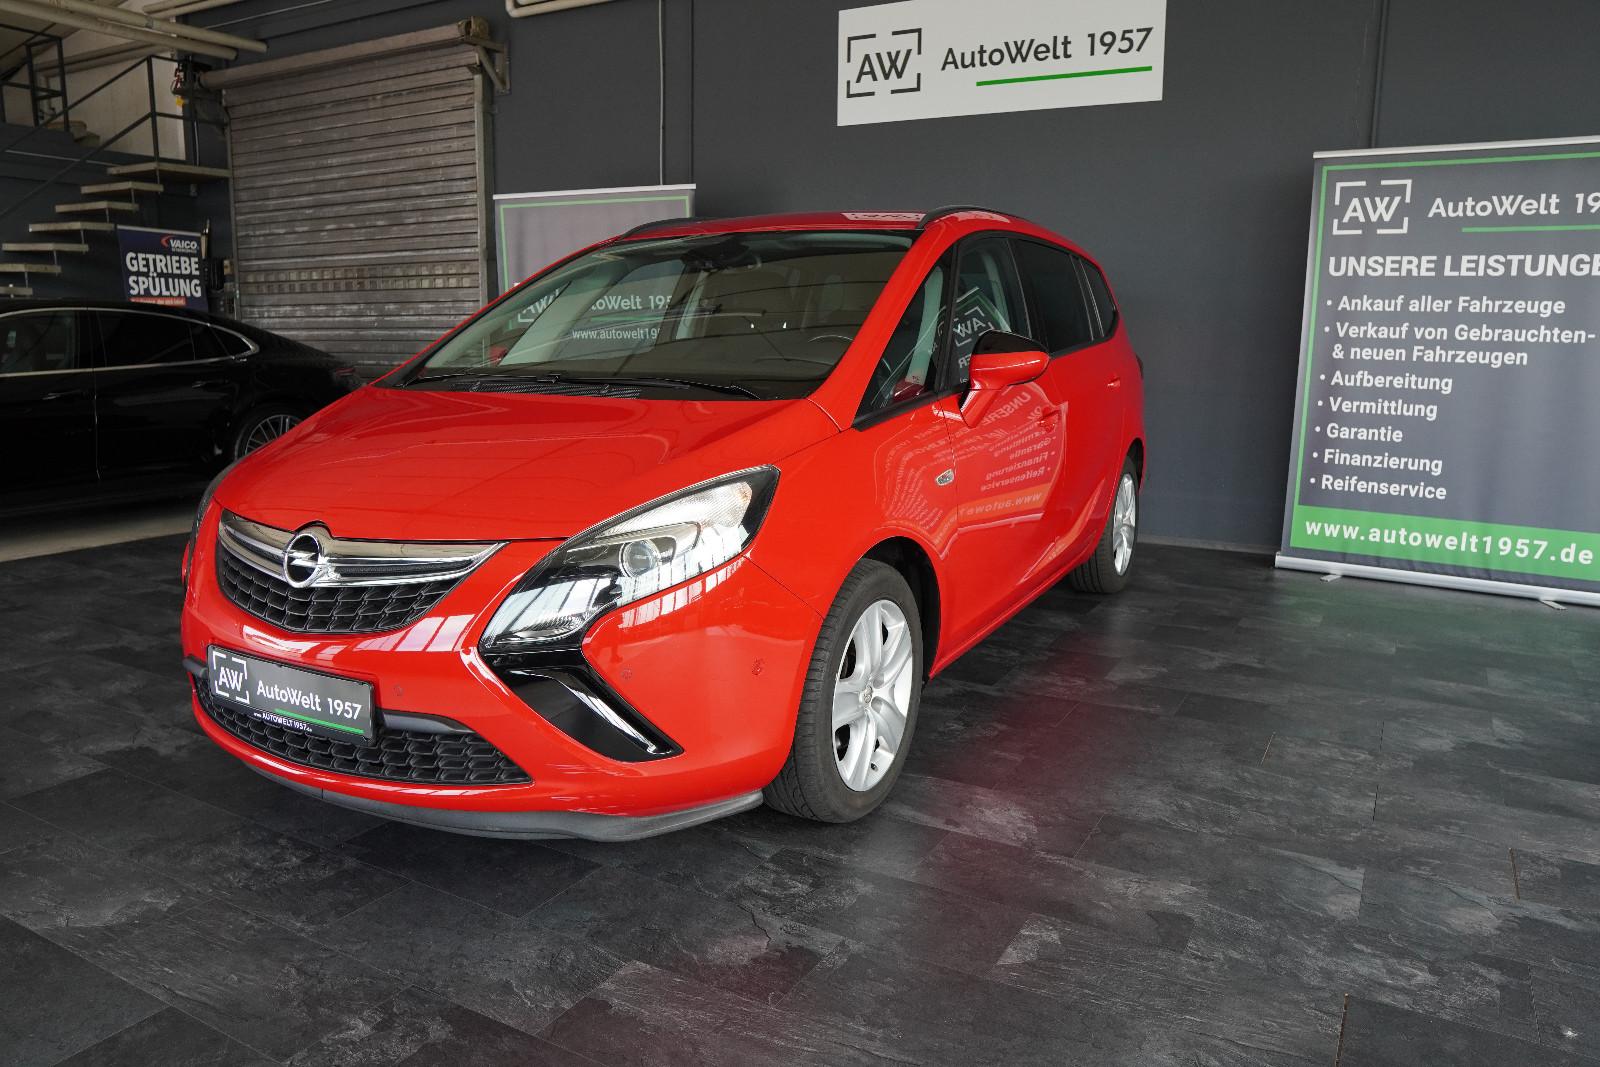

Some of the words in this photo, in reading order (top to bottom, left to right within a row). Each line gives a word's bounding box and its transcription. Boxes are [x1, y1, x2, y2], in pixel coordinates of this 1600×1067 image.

[941, 35, 1071, 71] AutoWelt
[1087, 27, 1153, 56] 1957
[856, 49, 912, 83] AW
[1343, 196, 1401, 222] AW
[1427, 193, 1560, 217] AutoWelt
[170, 239, 197, 249] VAICO
[126, 252, 200, 275] GETRIEBE
[1328, 256, 1437, 277] UNSERE
[128, 273, 202, 297] SPÜLUNG
[1337, 295, 1404, 312] Ankauf
[1408, 296, 1452, 312] aller
[1457, 296, 1566, 317] Fahrzeuge
[1336, 322, 1408, 339] Verkauf
[1413, 326, 1448, 340] von
[1454, 324, 1596, 343] Gebrauchten-
[1332, 344, 1344, 359] &
[1350, 346, 1406, 360] neuen
[1412, 346, 1528, 368] Fahrzeugen
[1331, 371, 1453, 394] Aufbereitung
[1328, 397, 1438, 421] Vermittlung
[1326, 423, 1403, 442] Garantie
[1324, 449, 1443, 475] Finanzierung
[1321, 475, 1447, 500] Reifenservice
[1305, 521, 1593, 564] www.autowelt1957.de
[218, 667, 244, 691] AW
[257, 680, 322, 712] AutoWelt
[328, 697, 363, 720] 1957
